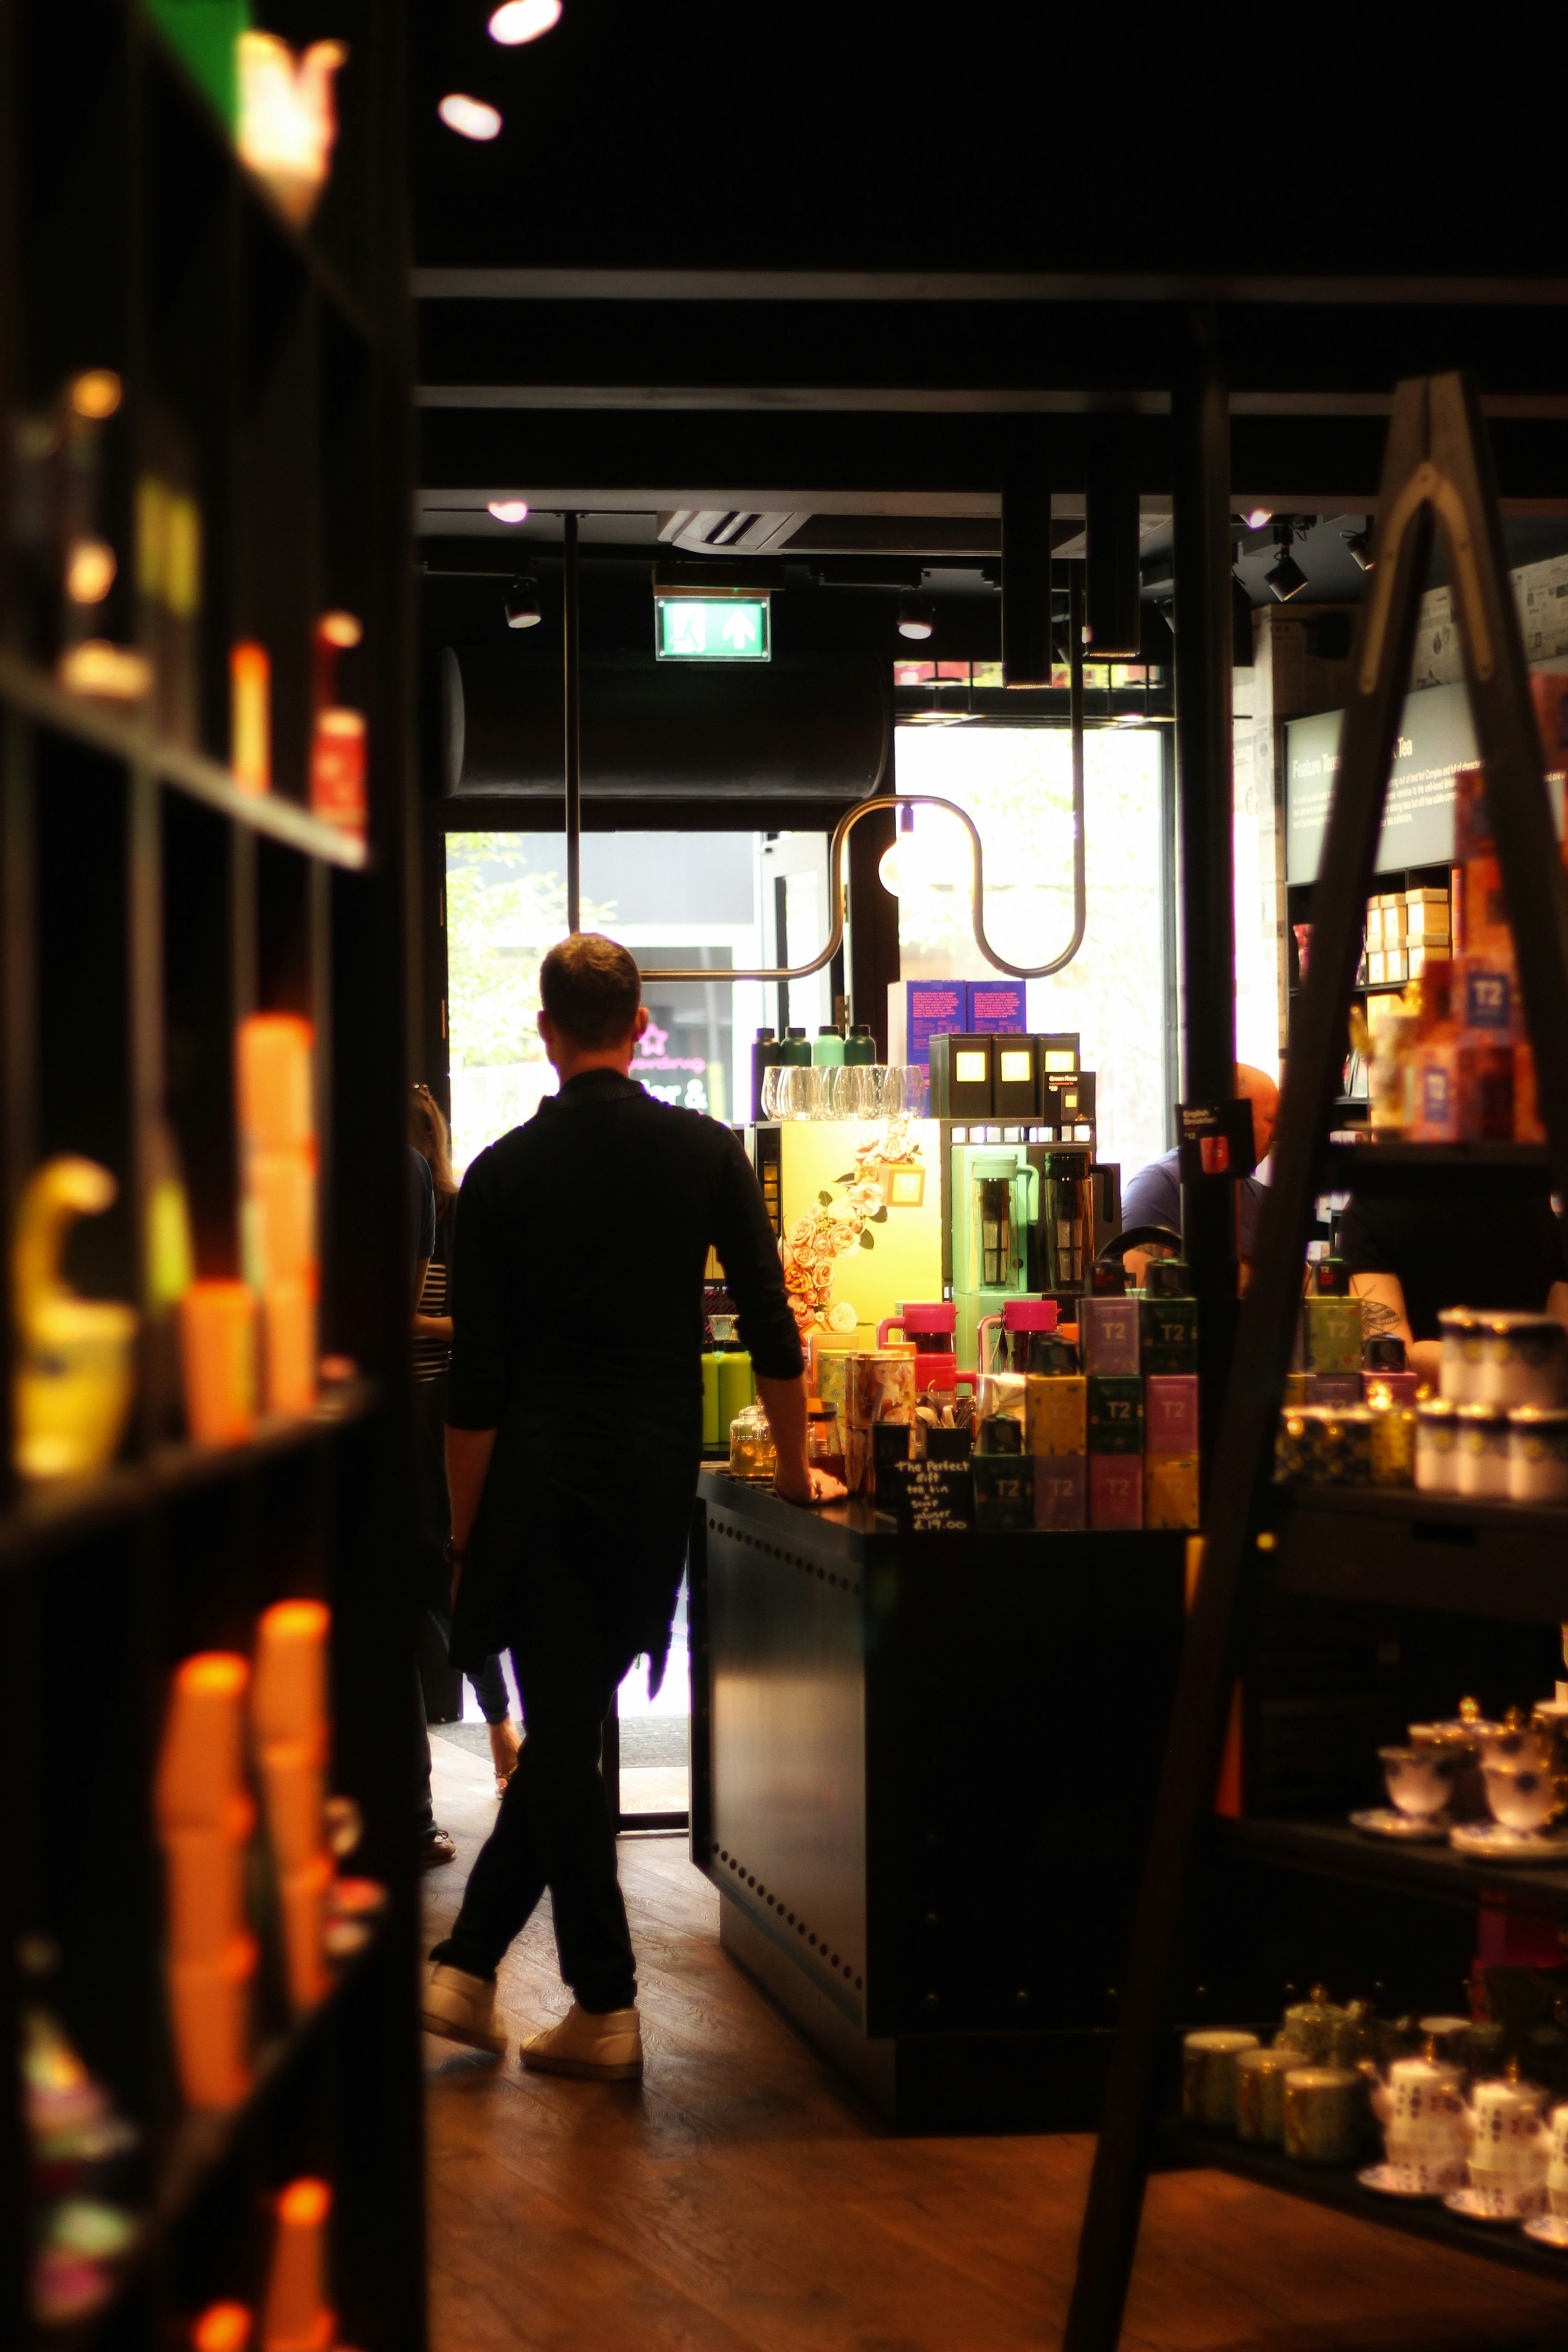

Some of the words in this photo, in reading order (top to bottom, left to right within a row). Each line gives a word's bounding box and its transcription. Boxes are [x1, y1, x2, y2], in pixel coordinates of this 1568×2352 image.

[1398, 737, 1413, 758] Tea
[1293, 759, 1322, 779] Feature
[684, 1078, 708, 1110] &
[1182, 1109, 1210, 1119] English
[899, 1177, 916, 1191] T2
[1101, 1322, 1126, 1340] T2
[1160, 1323, 1185, 1341] T2
[1327, 1321, 1350, 1338] T2
[1052, 1403, 1073, 1420] T2
[1106, 1401, 1131, 1420] T2
[1161, 1401, 1186, 1418] T2
[926, 1460, 970, 1472] Perfect
[906, 1485, 925, 1494] tea
[929, 1485, 949, 1494] tin
[995, 1479, 1021, 1498] T2
[1049, 1479, 1074, 1497] T2
[1106, 1479, 1131, 1496] T2
[1162, 1478, 1186, 1496] T2
[913, 1520, 967, 1531] £19.00
